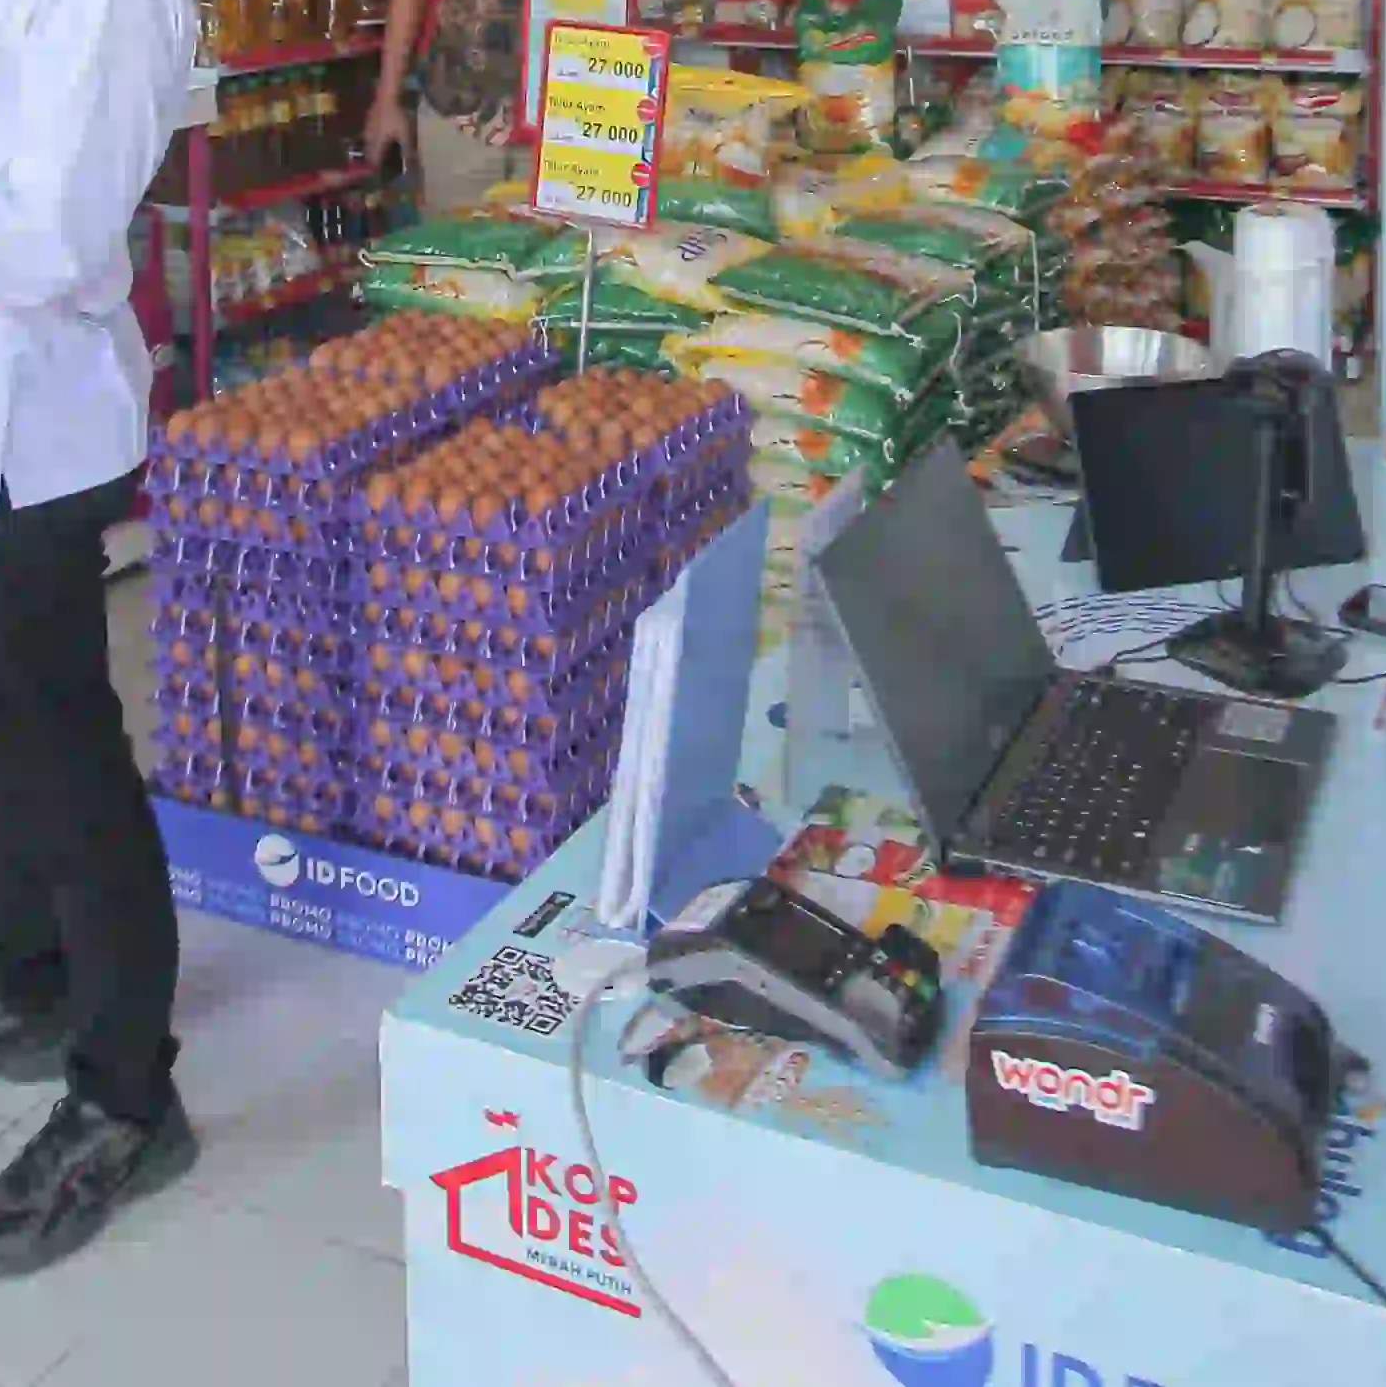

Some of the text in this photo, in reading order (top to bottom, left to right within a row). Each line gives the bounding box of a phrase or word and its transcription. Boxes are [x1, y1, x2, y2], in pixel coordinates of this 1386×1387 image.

[307, 857, 420, 907] ID FOOD
[270, 893, 332, 922] PROMO
[270, 911, 332, 940] PROMO
[998, 1055, 1148, 1110] wondr
[525, 1146, 639, 1218] KOP
[526, 1195, 632, 1268] DES
[526, 1246, 633, 1296] MERAH PUTIH
